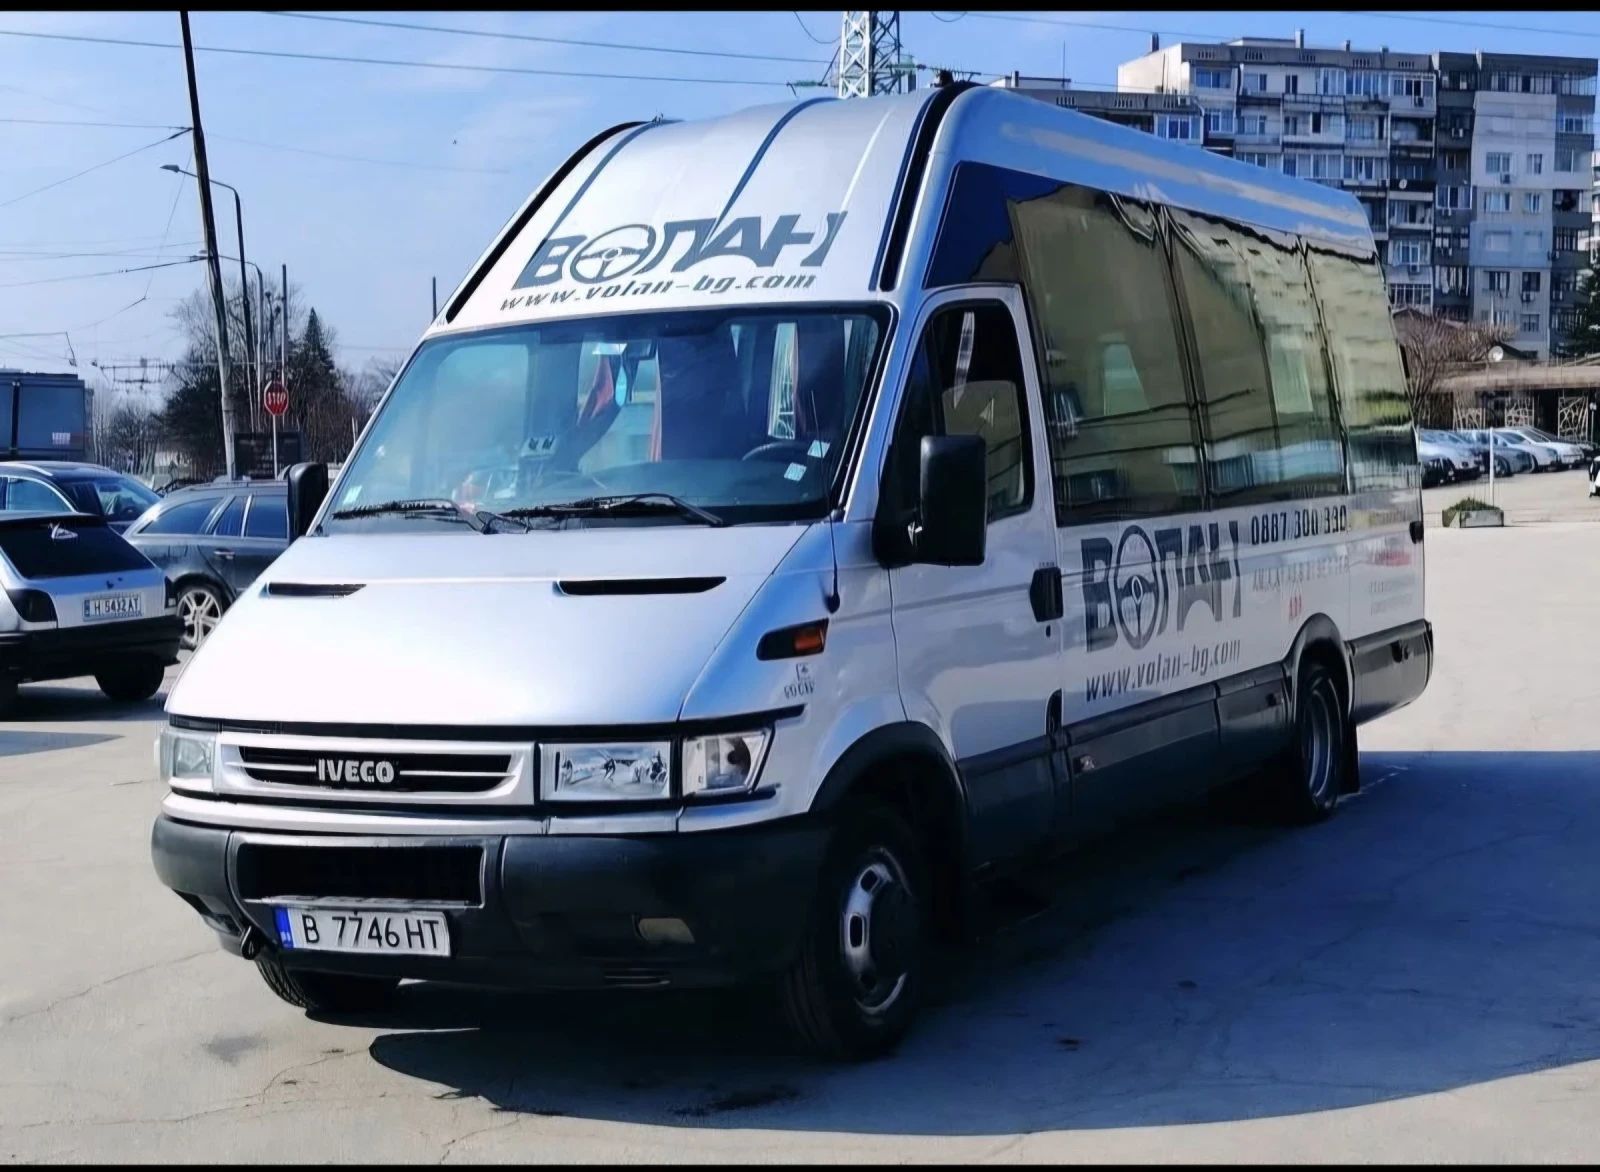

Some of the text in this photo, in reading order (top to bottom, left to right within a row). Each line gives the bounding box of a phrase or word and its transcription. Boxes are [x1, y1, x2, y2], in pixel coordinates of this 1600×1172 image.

[500, 274, 818, 311] www.volan-bg.com
[1251, 511, 1288, 545] 0887
[1085, 639, 1241, 702] www.volan-bg.com
[318, 759, 395, 783] IVECO
